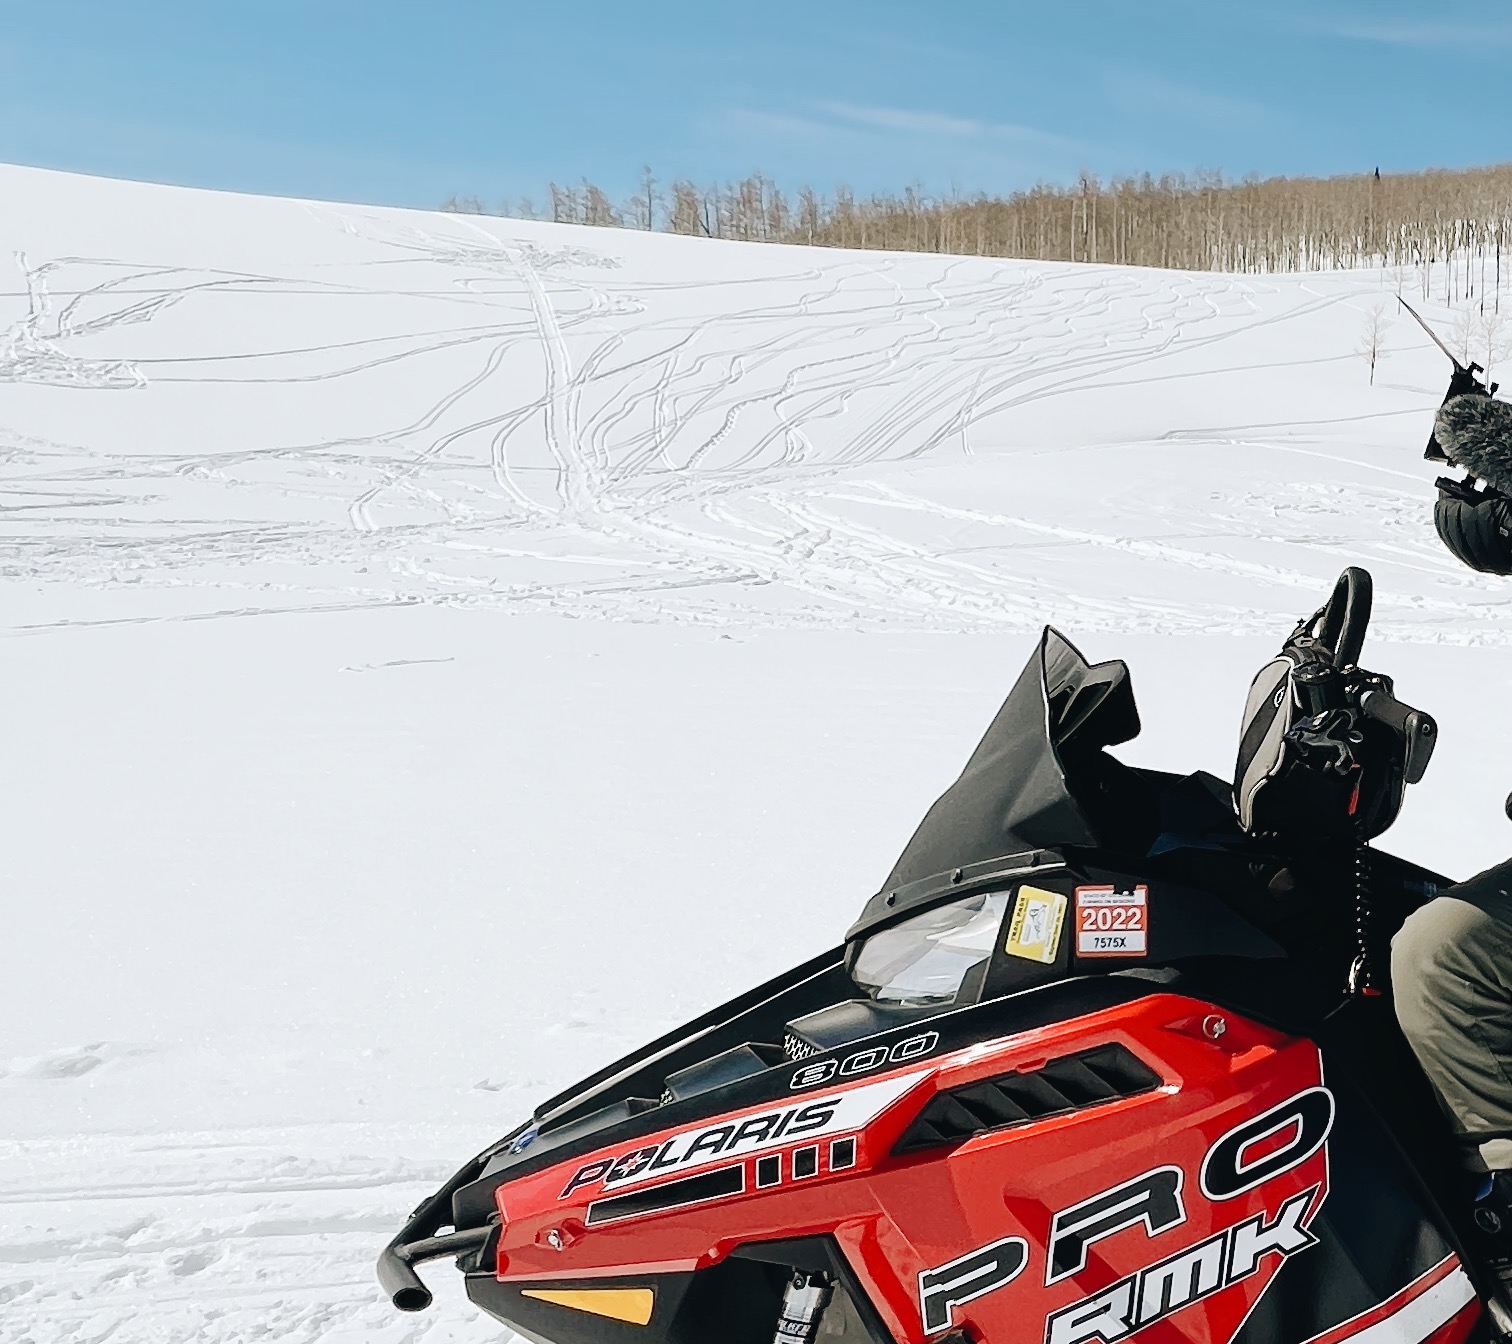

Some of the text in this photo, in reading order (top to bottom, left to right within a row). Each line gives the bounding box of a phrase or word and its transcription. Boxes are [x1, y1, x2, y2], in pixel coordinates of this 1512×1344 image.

[1081, 907, 1143, 931] 2022
[1094, 936, 1127, 949] 7575X
[789, 1030, 940, 1090] 800
[557, 1097, 843, 1200] POLARIS
[918, 1086, 1335, 1336] PRO
